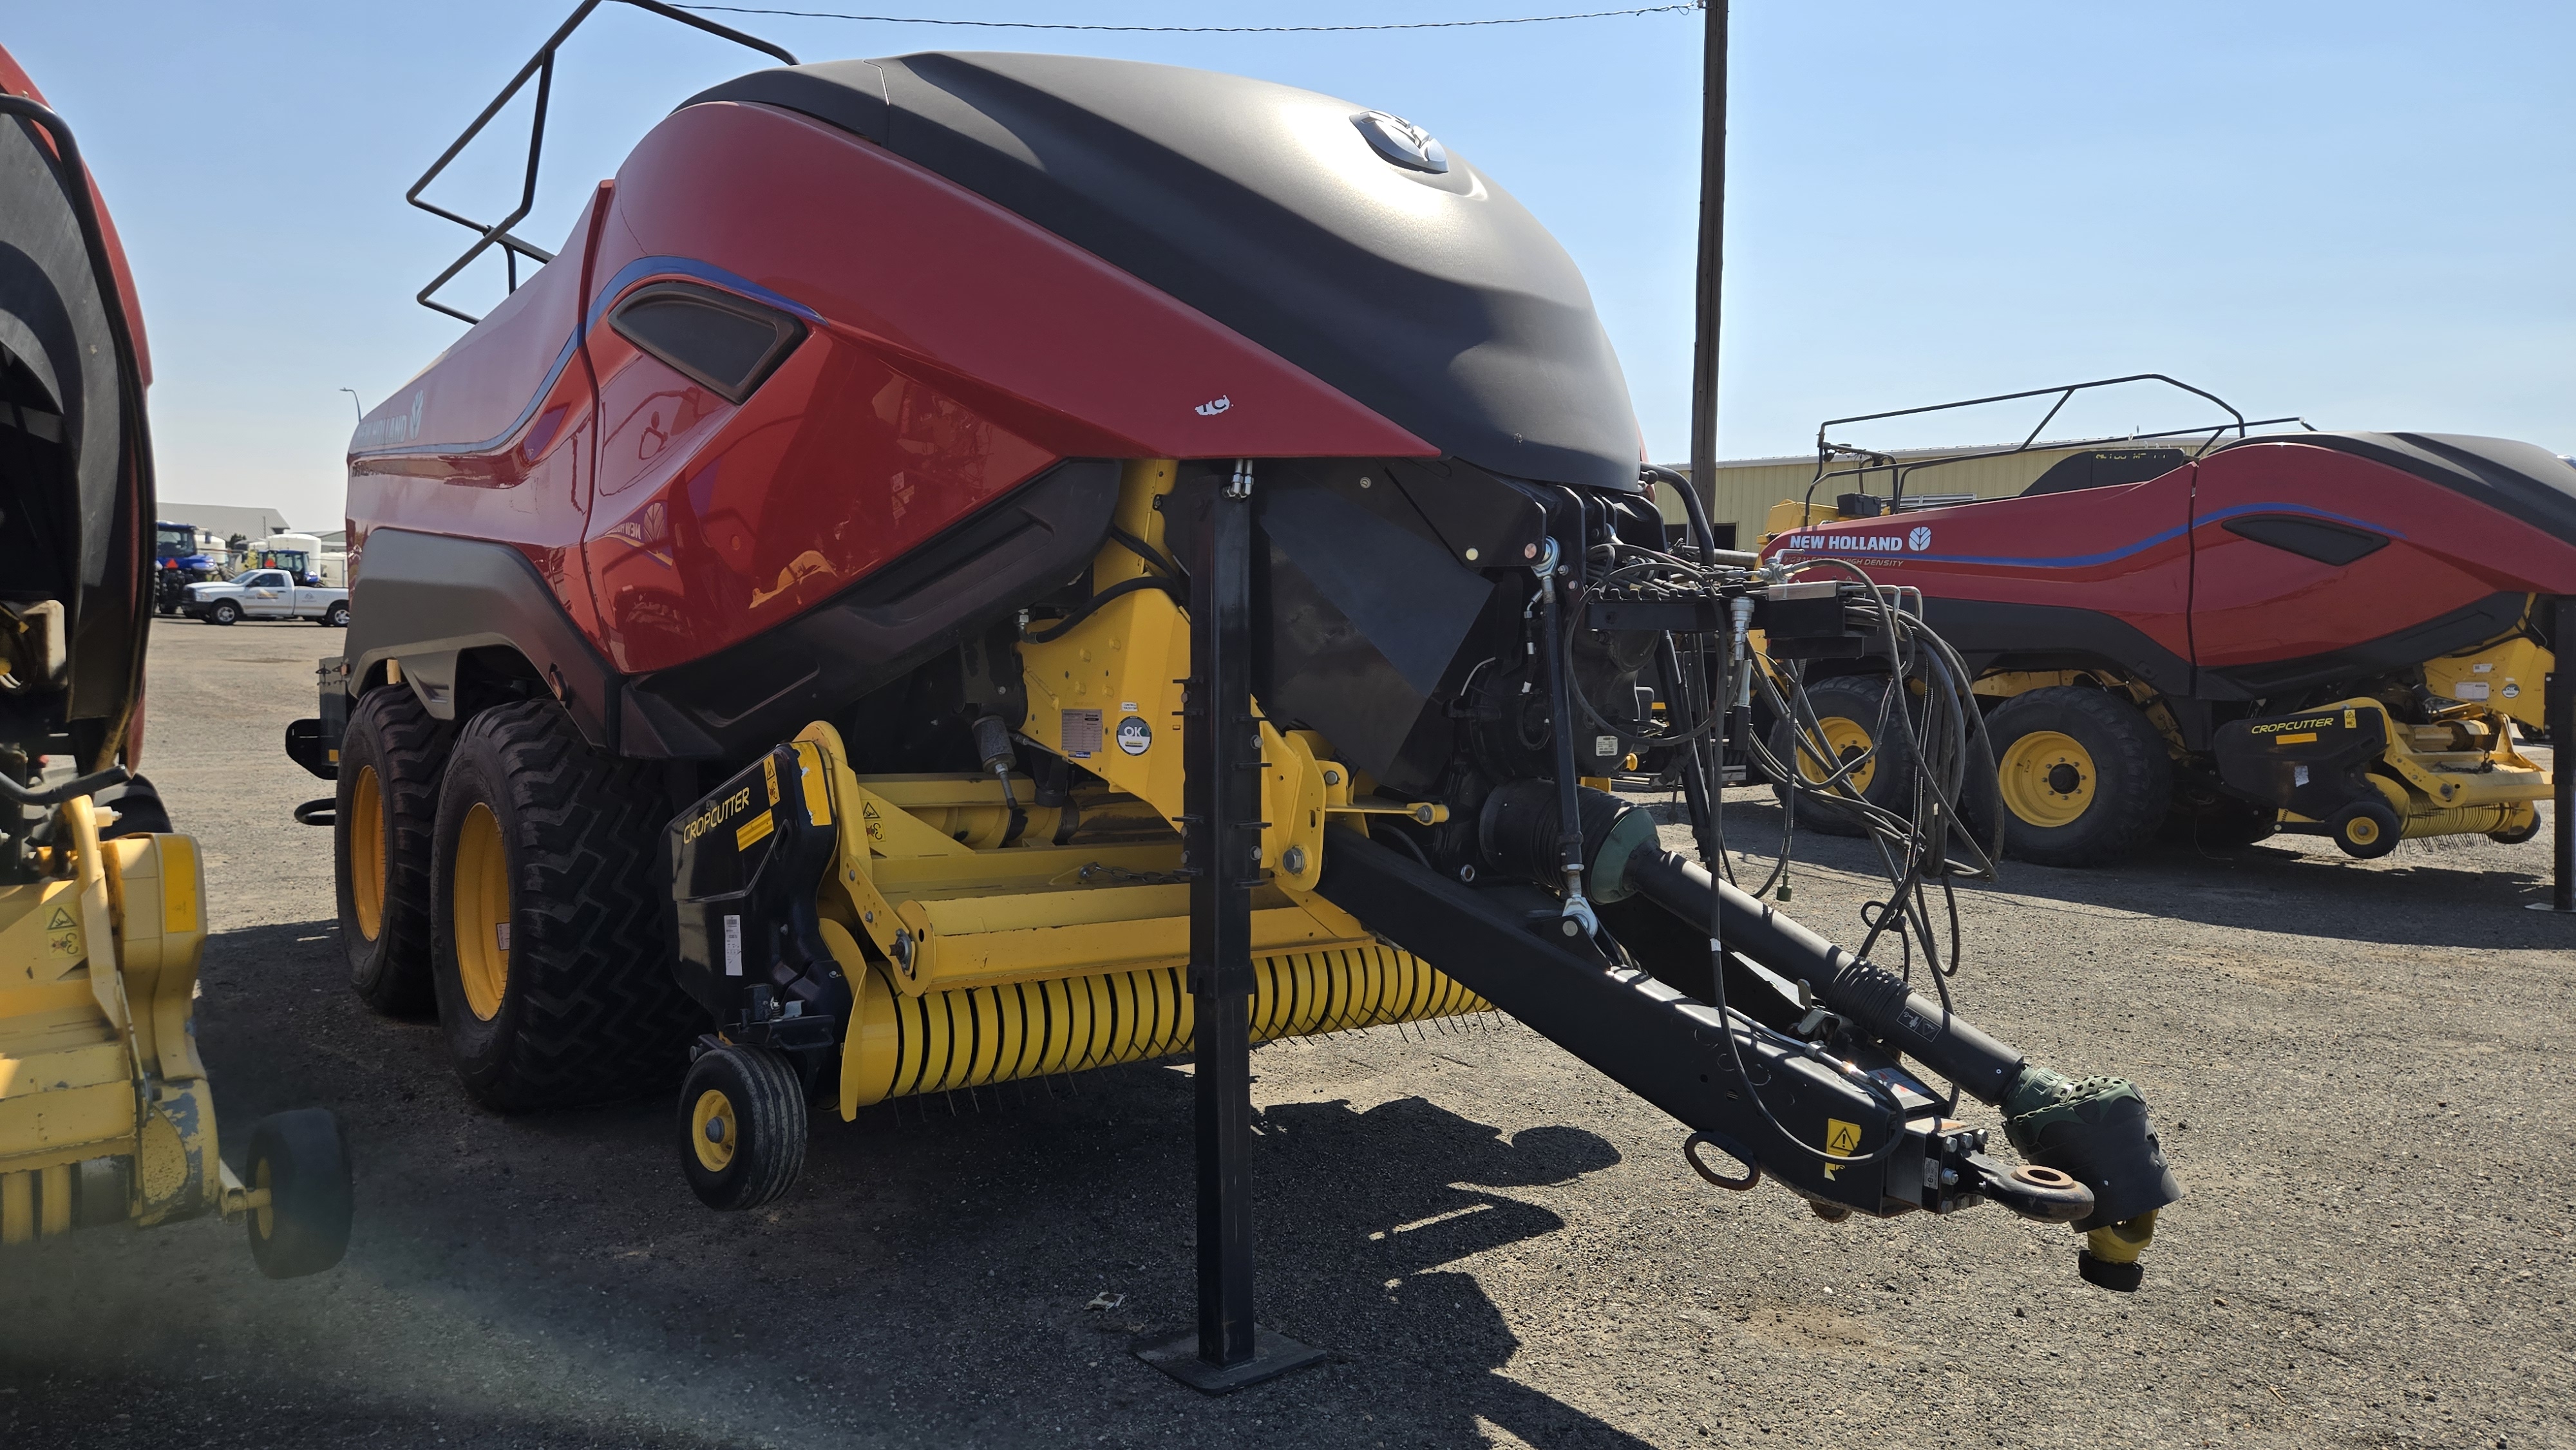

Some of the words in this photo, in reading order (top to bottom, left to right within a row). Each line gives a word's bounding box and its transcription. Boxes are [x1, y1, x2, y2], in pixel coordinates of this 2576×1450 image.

[372, 415, 407, 445] HOLLAND
[1790, 535, 1825, 549] NEW
[1828, 536, 1902, 551] HOLLAND
[1864, 559, 1904, 567] DENSITY
[1124, 726, 1142, 737] OK
[2251, 717, 2334, 734] CROPCUTTER
[683, 787, 750, 844] CROPCUTTER
